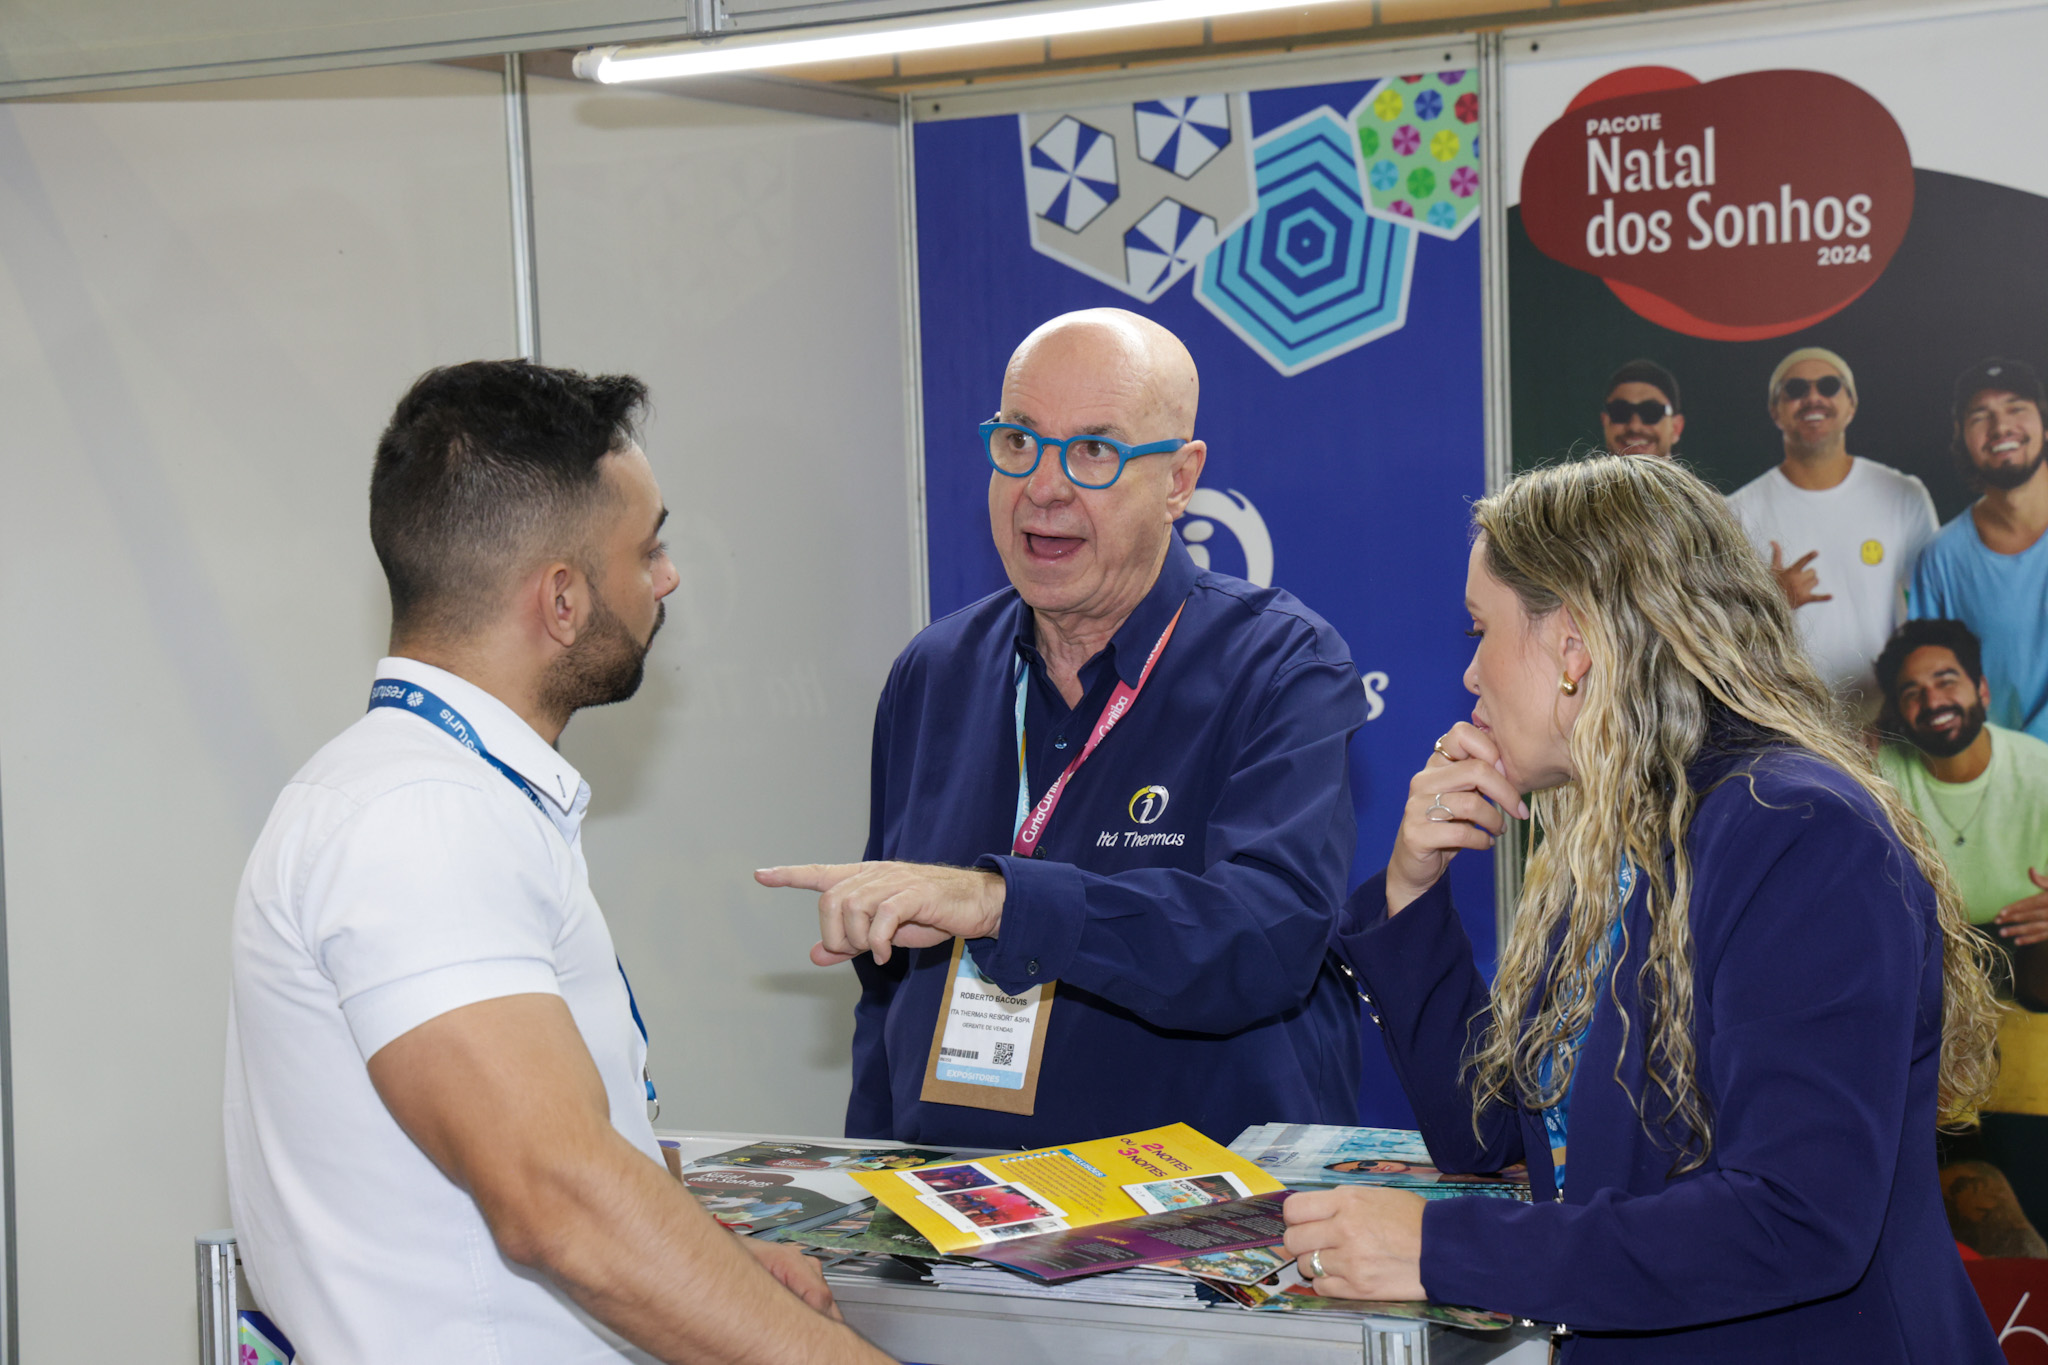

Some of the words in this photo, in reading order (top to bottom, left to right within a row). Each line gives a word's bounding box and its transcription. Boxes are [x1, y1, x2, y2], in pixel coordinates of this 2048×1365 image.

[1586, 113, 1661, 136] PACOTE
[1586, 126, 1715, 195] Natal
[1586, 199, 1672, 257] dos
[1687, 184, 1872, 250] Sonhos
[1817, 245, 1871, 266] 2024
[1096, 831, 1118, 847] Itá
[1123, 831, 1186, 847] Thermas
[960, 991, 995, 1002] ROBERTO
[995, 996, 1028, 1006] BACOVIS
[960, 1010, 988, 1019] THERMAS
[989, 1013, 1014, 1021] RESORT
[946, 1069, 1000, 1083] EXPOSITORES
[1117, 1147, 1140, 1156] 3
[1140, 1143, 1164, 1152] 2
[1127, 1155, 1168, 1178] NOITES
[1151, 1150, 1193, 1172] NOITES
